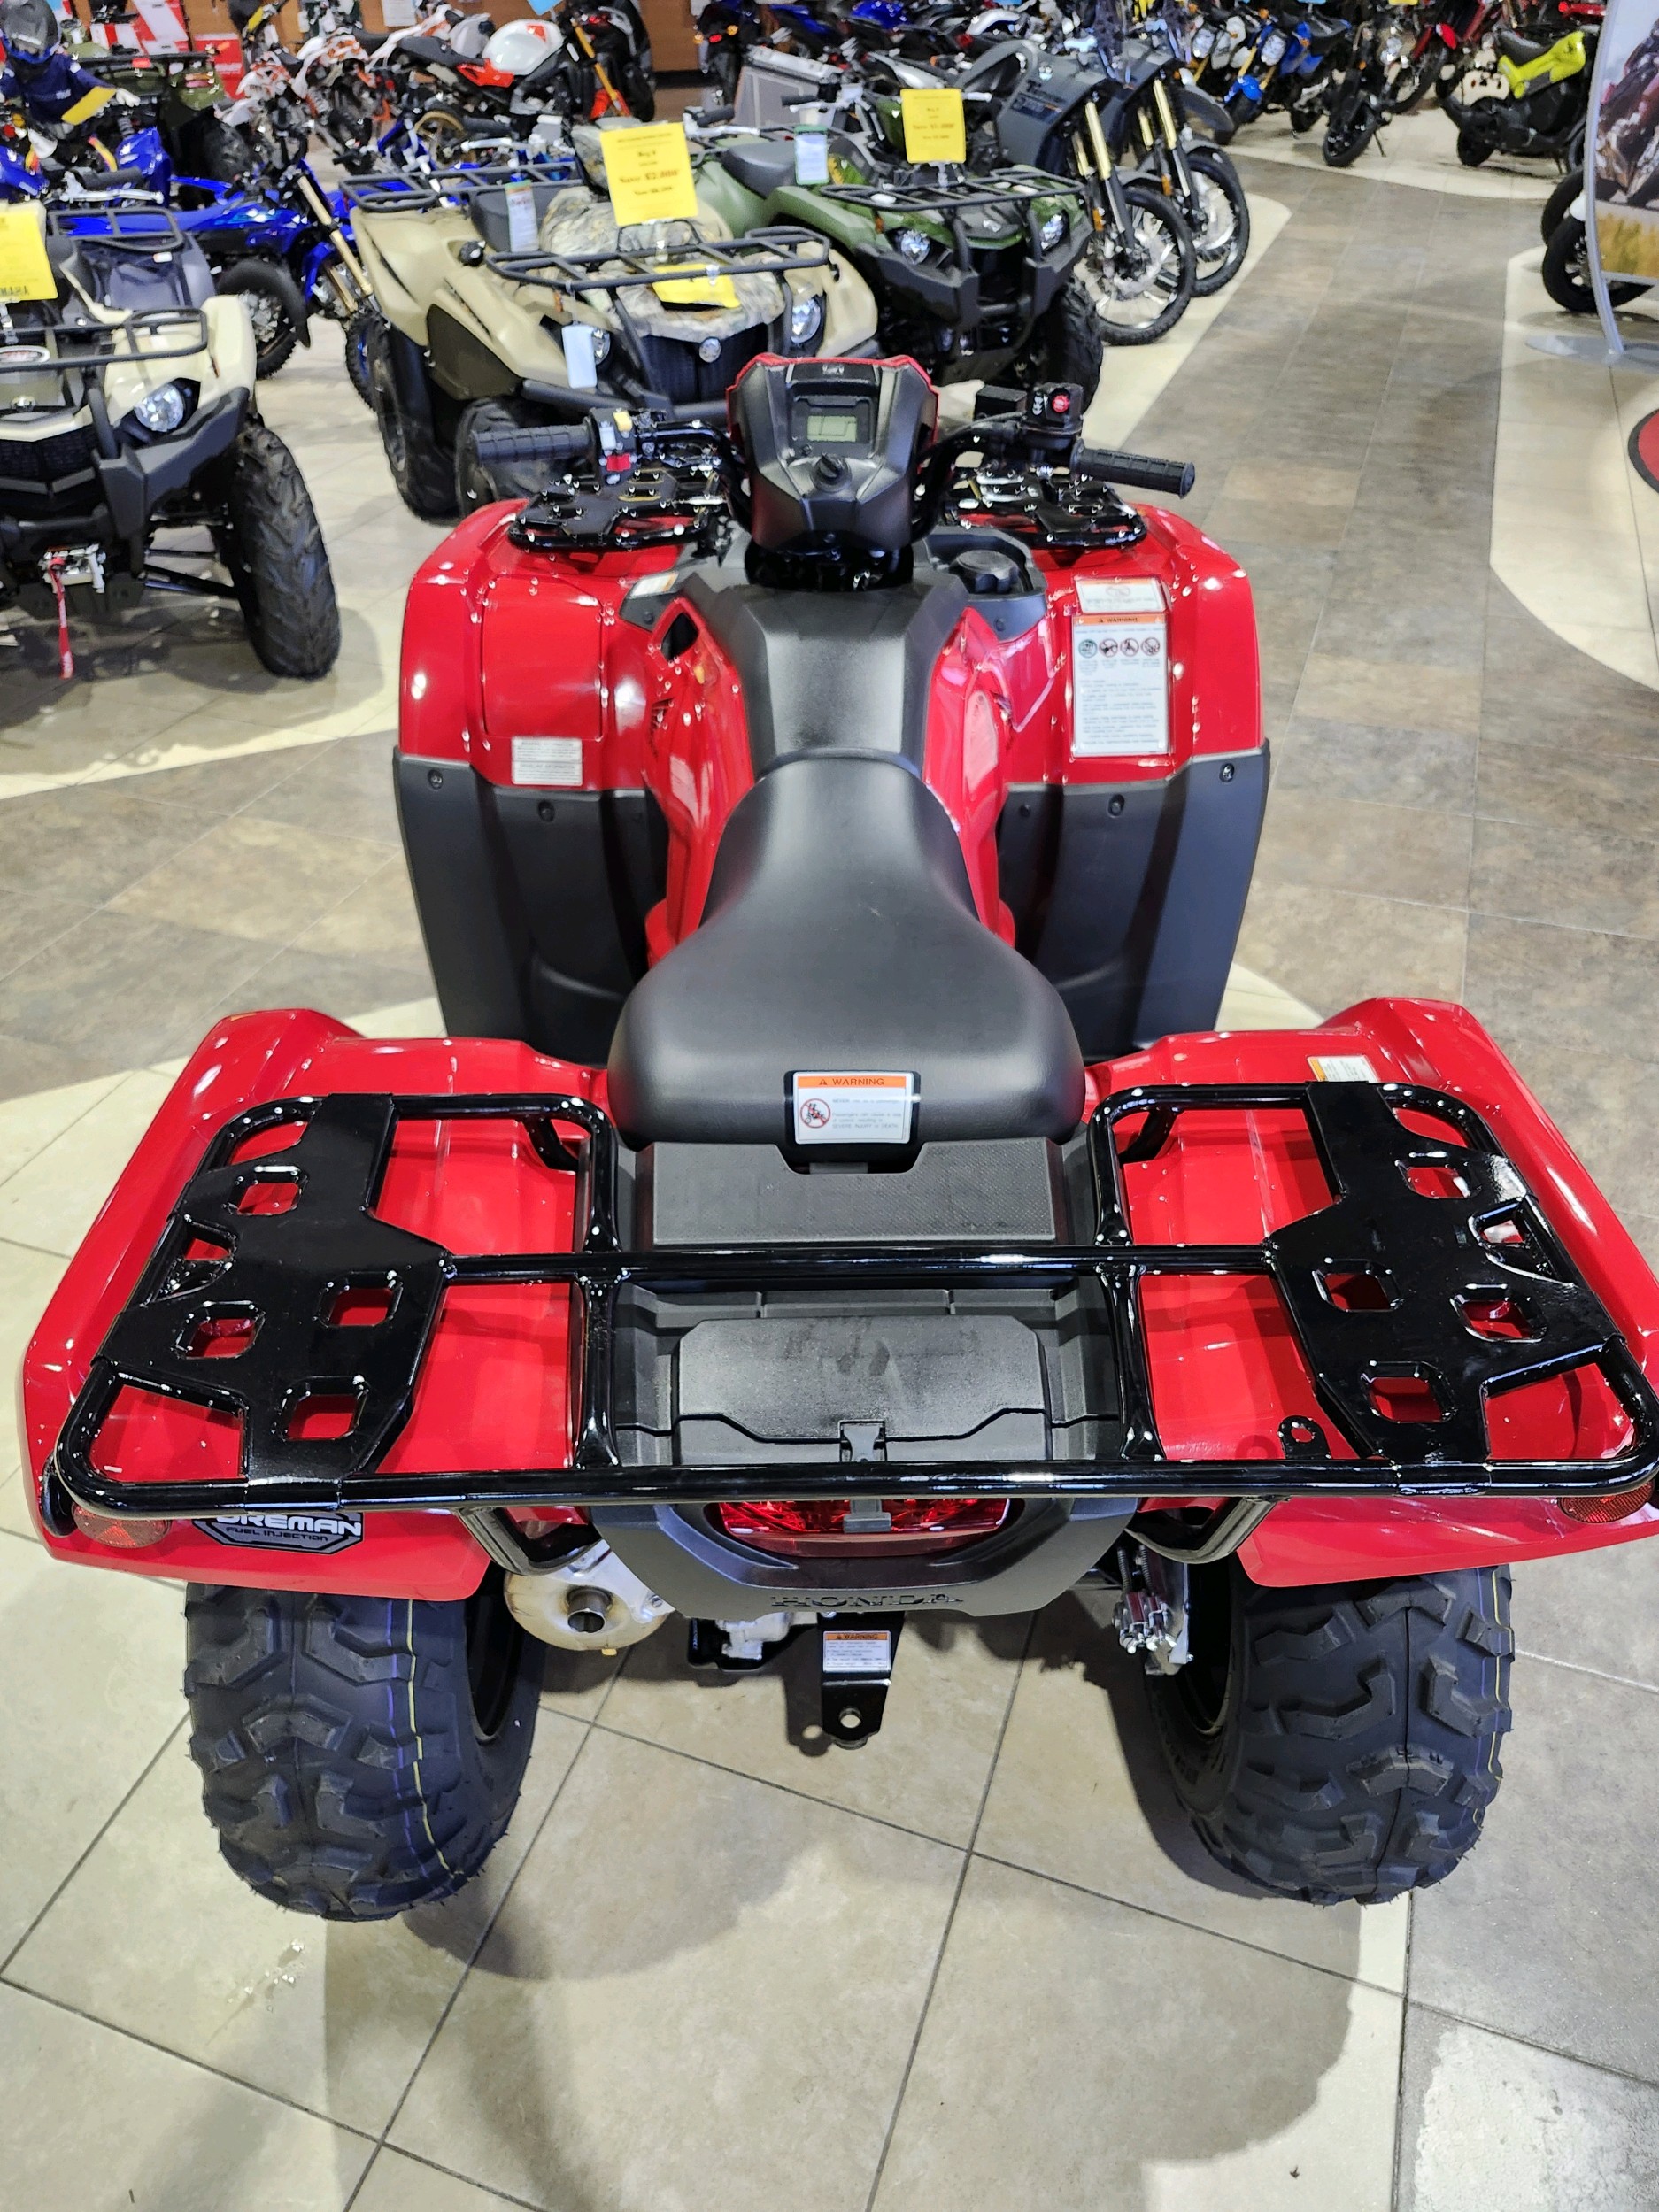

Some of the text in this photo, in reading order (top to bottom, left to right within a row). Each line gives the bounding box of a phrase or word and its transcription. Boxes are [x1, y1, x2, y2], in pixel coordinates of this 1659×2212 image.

[216, 1514, 362, 1537] OREMAN
[226, 1526, 328, 1542] FUEL INJECTION
[771, 1593, 964, 1607] HONDA
